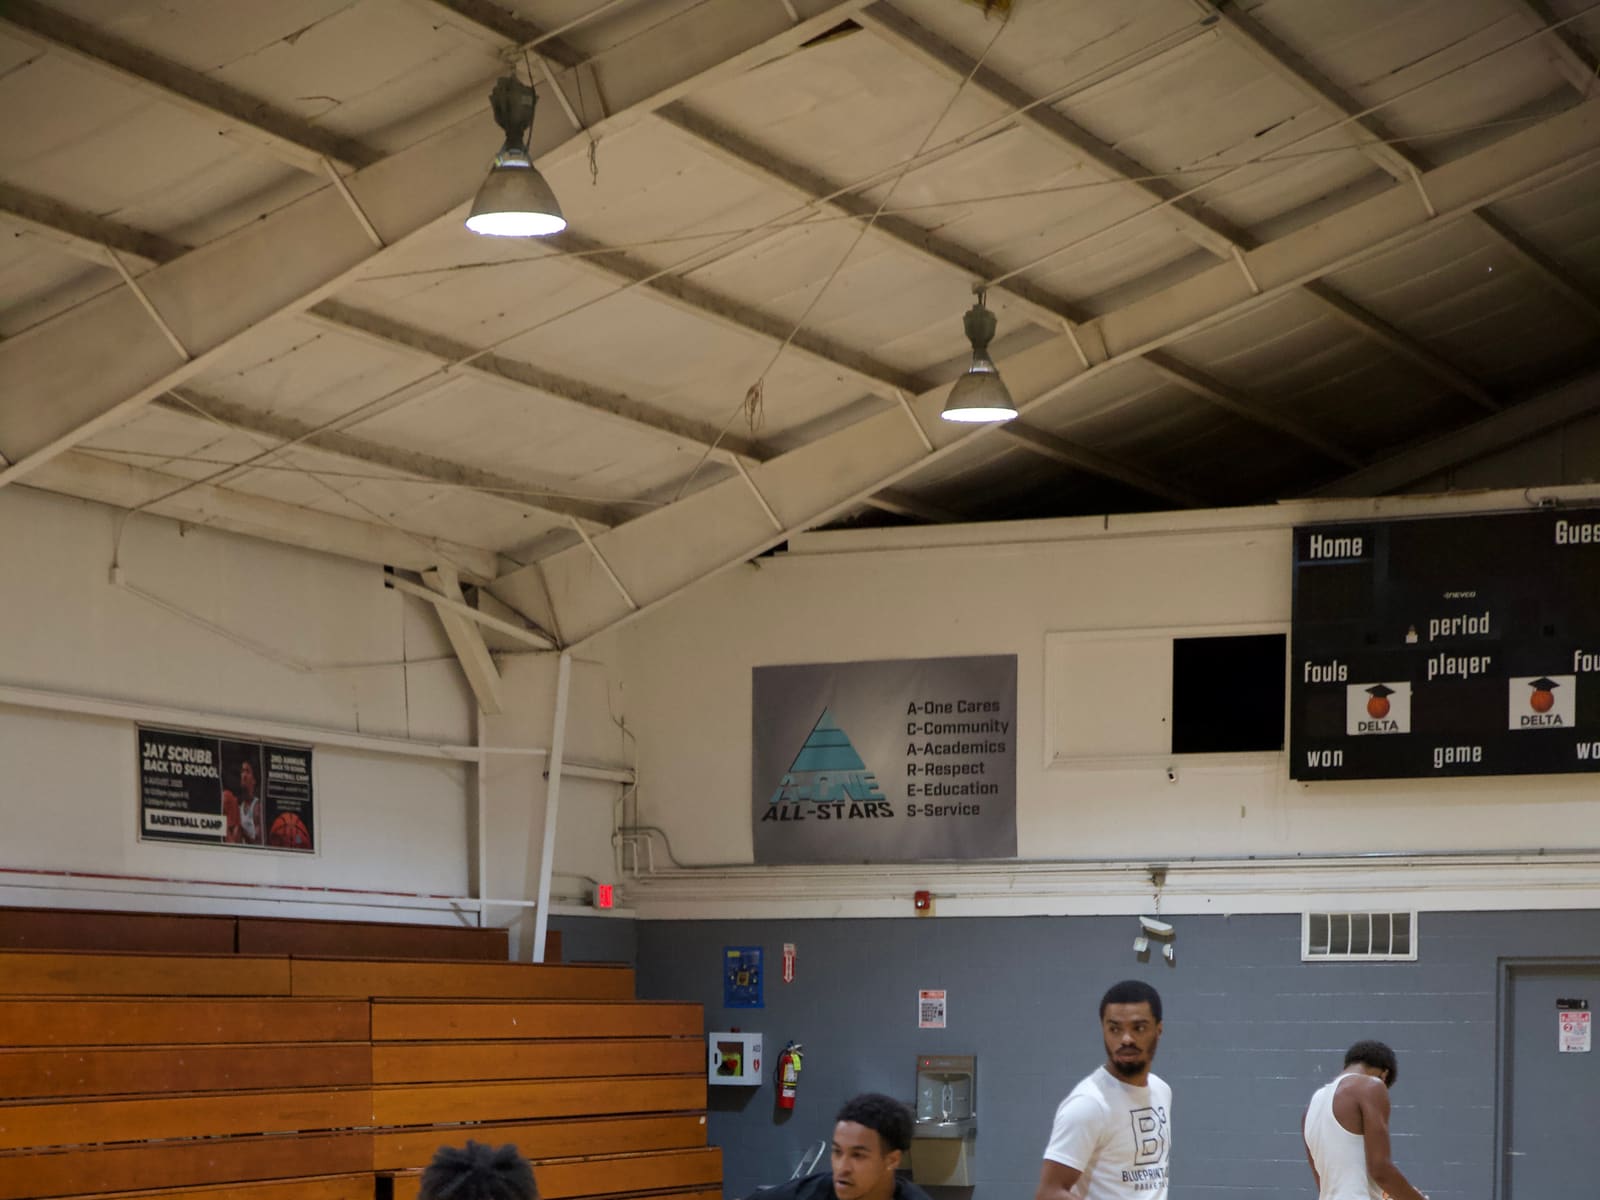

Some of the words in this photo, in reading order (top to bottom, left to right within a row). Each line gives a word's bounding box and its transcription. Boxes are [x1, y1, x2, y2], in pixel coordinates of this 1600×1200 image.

[1309, 534, 1363, 559] Home
[1429, 611, 1490, 642] period
[1304, 660, 1348, 683] fouls
[1427, 653, 1491, 681] player
[907, 701, 953, 715] A-One
[957, 700, 1001, 713] Cares
[907, 719, 1009, 735] C-Community
[1358, 720, 1399, 732] DELTA
[1520, 714, 1563, 726] DELTA
[143, 743, 166, 759] JAY
[168, 746, 212, 765] SCRUBB
[906, 741, 1006, 756] A-Academics
[1433, 746, 1482, 768] game
[1307, 750, 1343, 767] won
[143, 758, 169, 773] BACK
[171, 762, 183, 775] TO
[184, 763, 219, 778] SCHOOL
[907, 762, 985, 777] R-Respect
[907, 781, 998, 797] E-Education
[761, 802, 894, 821] ALL-STARS
[907, 802, 981, 817] S-Service
[150, 814, 199, 829] BASKETBALL
[201, 818, 222, 831] CAMP
